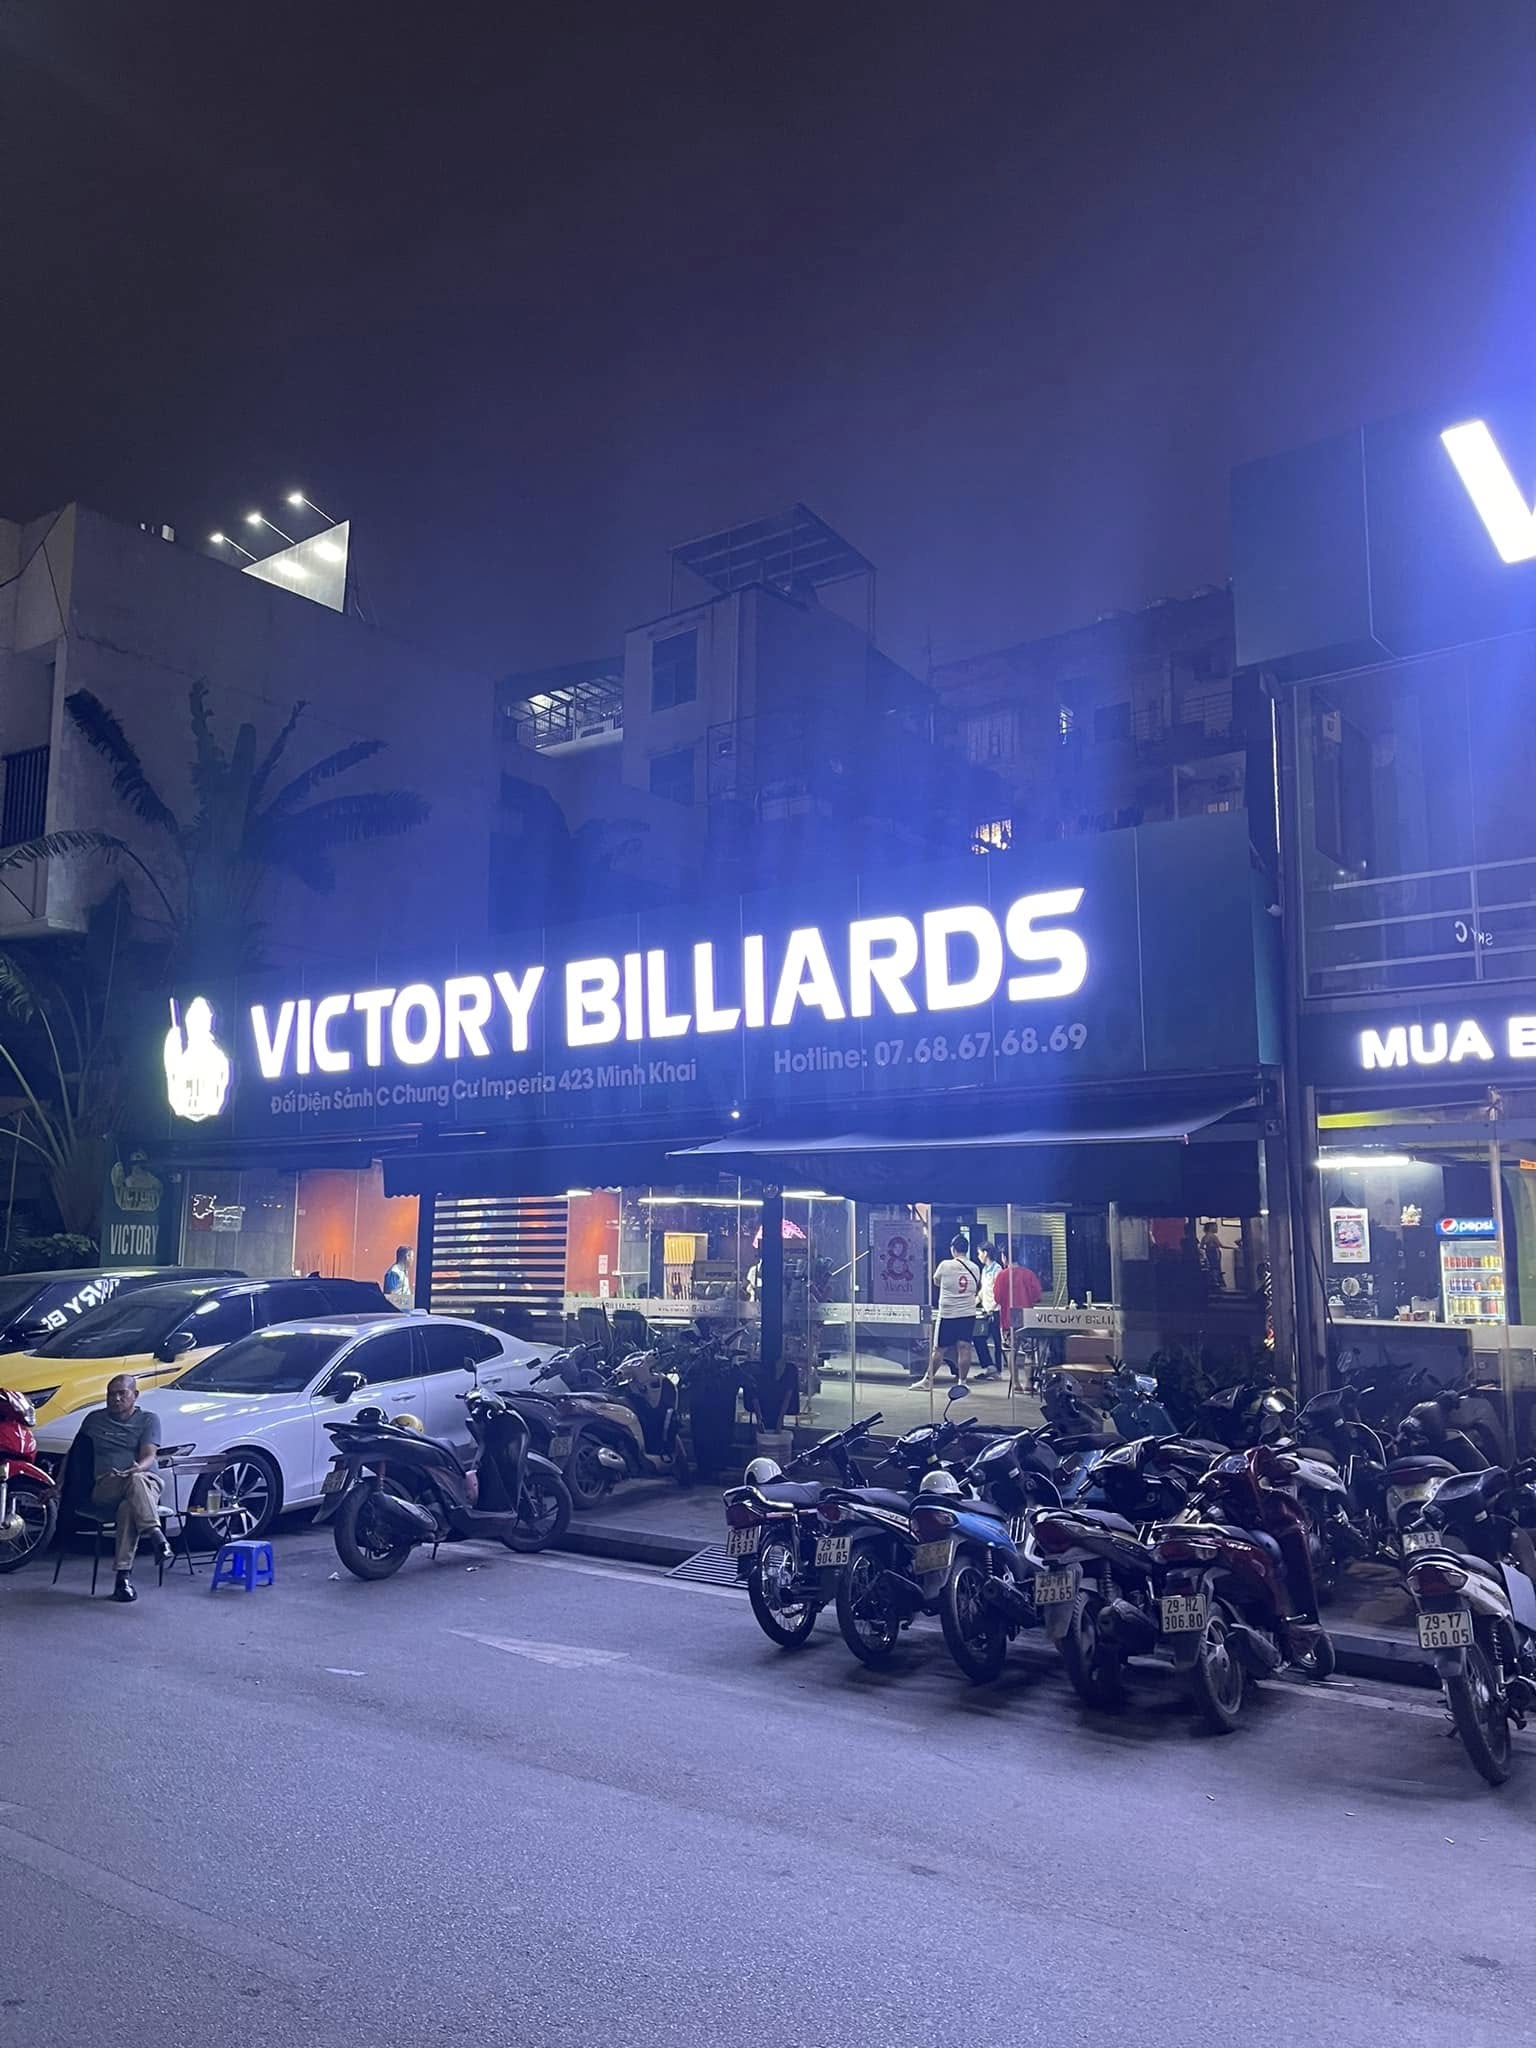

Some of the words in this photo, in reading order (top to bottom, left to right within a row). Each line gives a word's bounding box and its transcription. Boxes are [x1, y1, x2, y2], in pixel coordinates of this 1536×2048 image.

[251, 966, 545, 1078] VICTORY
[566, 887, 1088, 1047] BILLIARDS
[774, 1045, 868, 1074] Hotline:
[874, 1023, 1088, 1067] 07.68.67.68.69
[1361, 1020, 1494, 1069] MUA
[270, 1088, 297, 1114] Đối
[298, 1089, 330, 1116] Diện
[333, 1085, 373, 1110] Sảnh
[376, 1086, 390, 1106] C
[392, 1083, 450, 1107] Chung
[452, 1077, 480, 1099] Cư
[481, 1072, 556, 1099] Imperia
[558, 1067, 594, 1091] 423
[596, 1063, 646, 1088] Minh
[648, 1058, 697, 1084] Khai
[1459, 1219, 1495, 1233] pepsi
[110, 1223, 159, 1255] VICTORY
[958, 1275, 969, 1294] 9
[1037, 1313, 1081, 1324] VICTORY
[1164, 1613, 1203, 1630] 306.80
[1424, 1613, 1462, 1631] 29-Y7
[1422, 1629, 1469, 1647] 360.05
